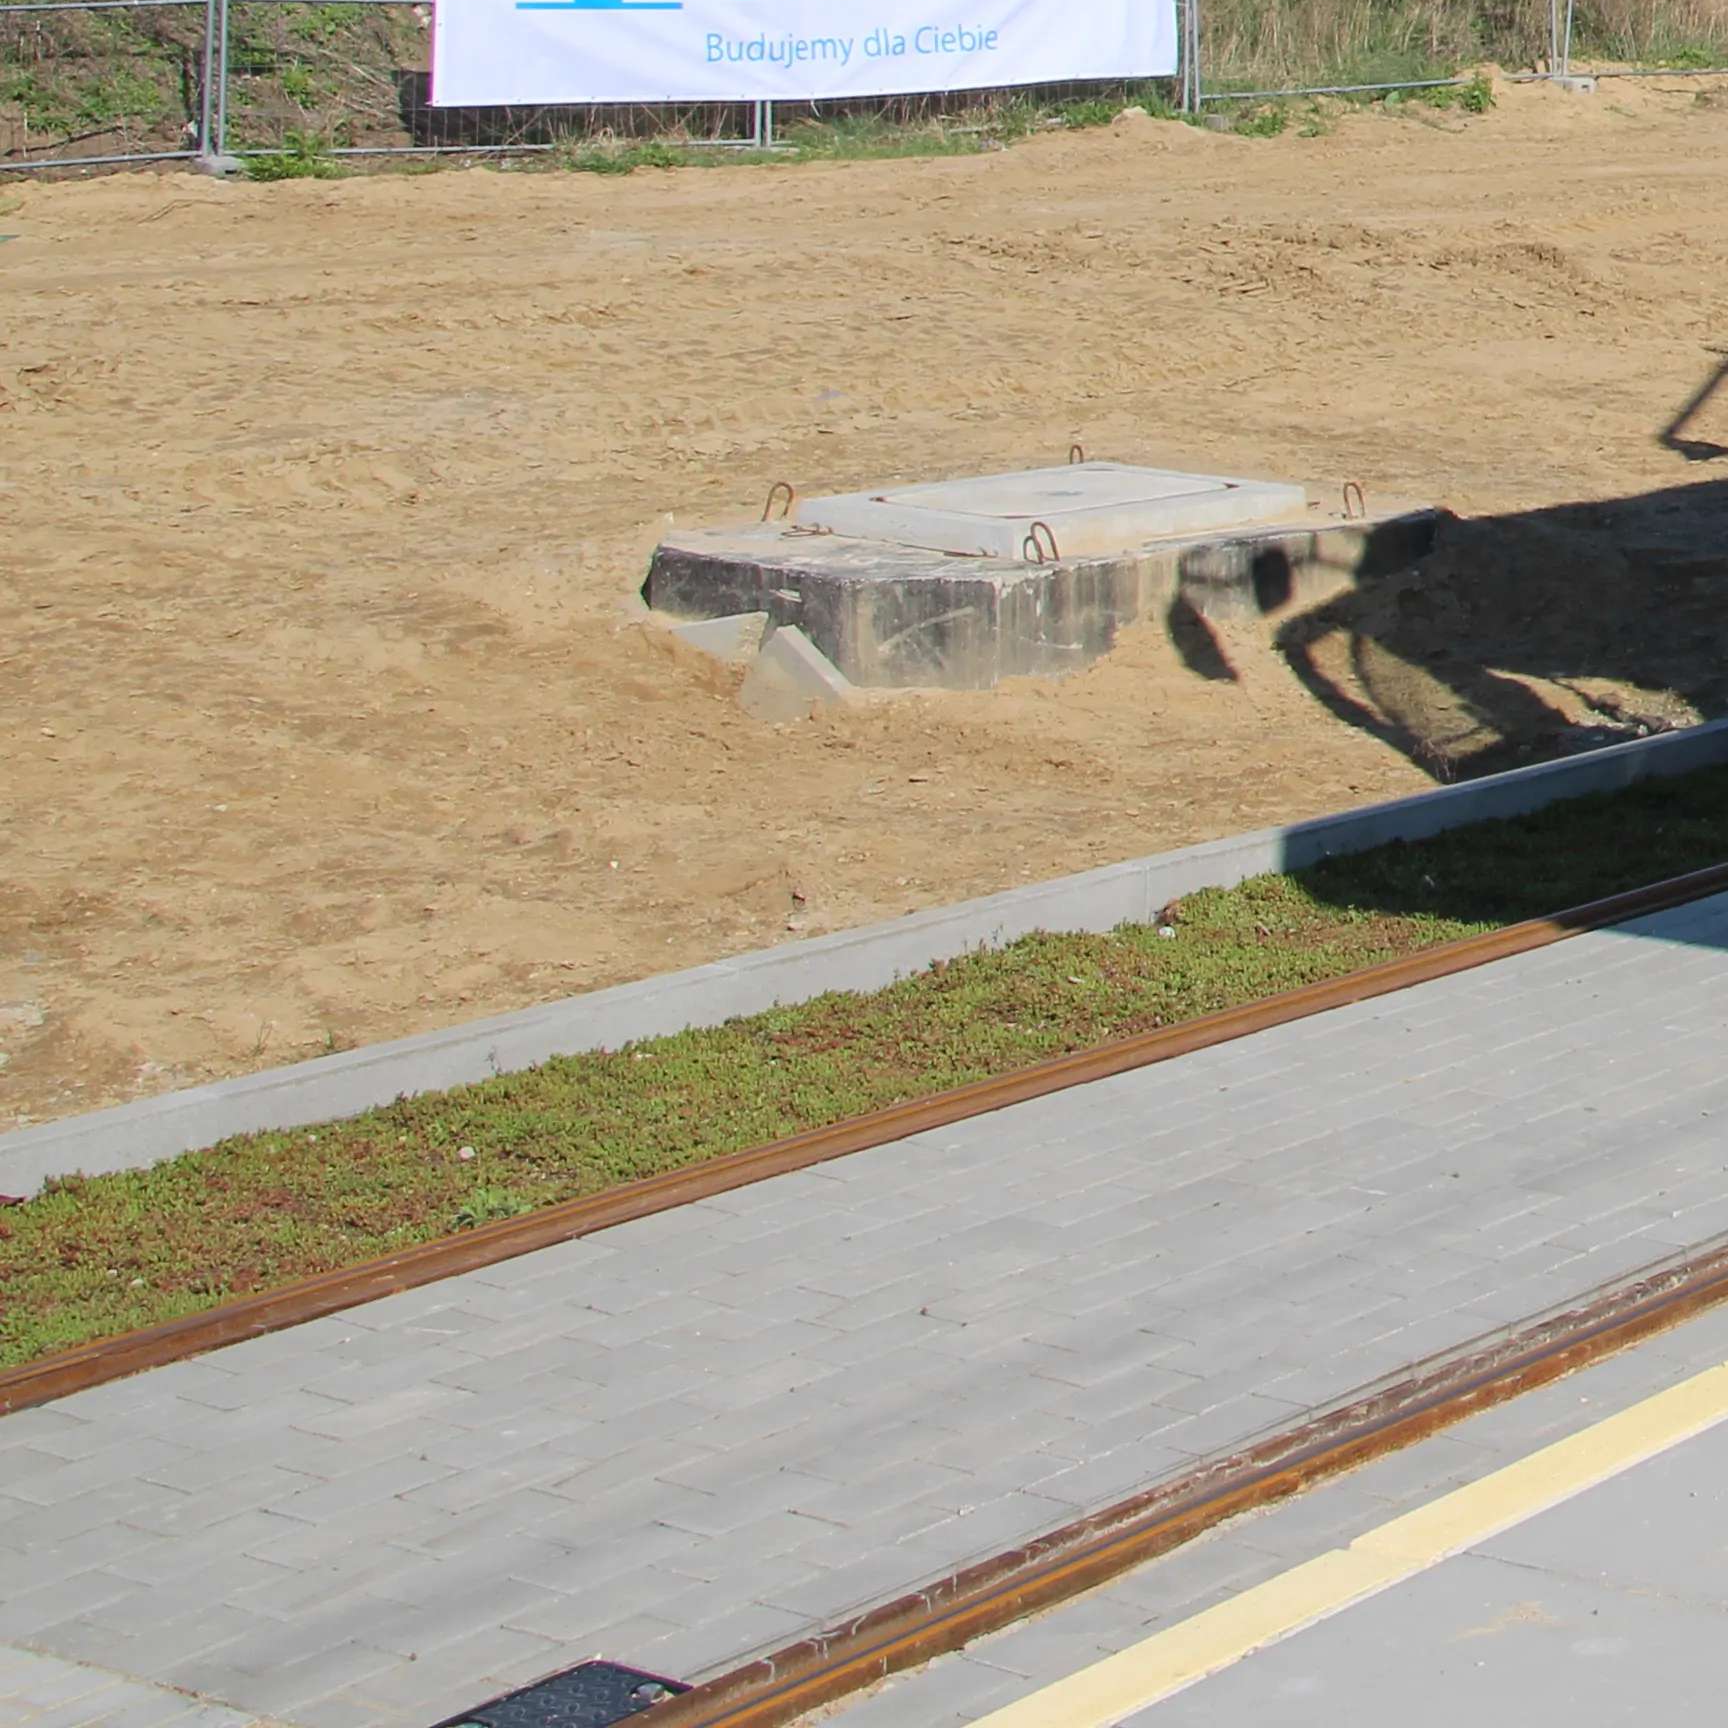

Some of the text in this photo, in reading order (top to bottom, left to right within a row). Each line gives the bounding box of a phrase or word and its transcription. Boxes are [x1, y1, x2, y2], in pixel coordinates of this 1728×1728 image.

[704, 23, 1000, 69] Budujemy dla Ciebie
